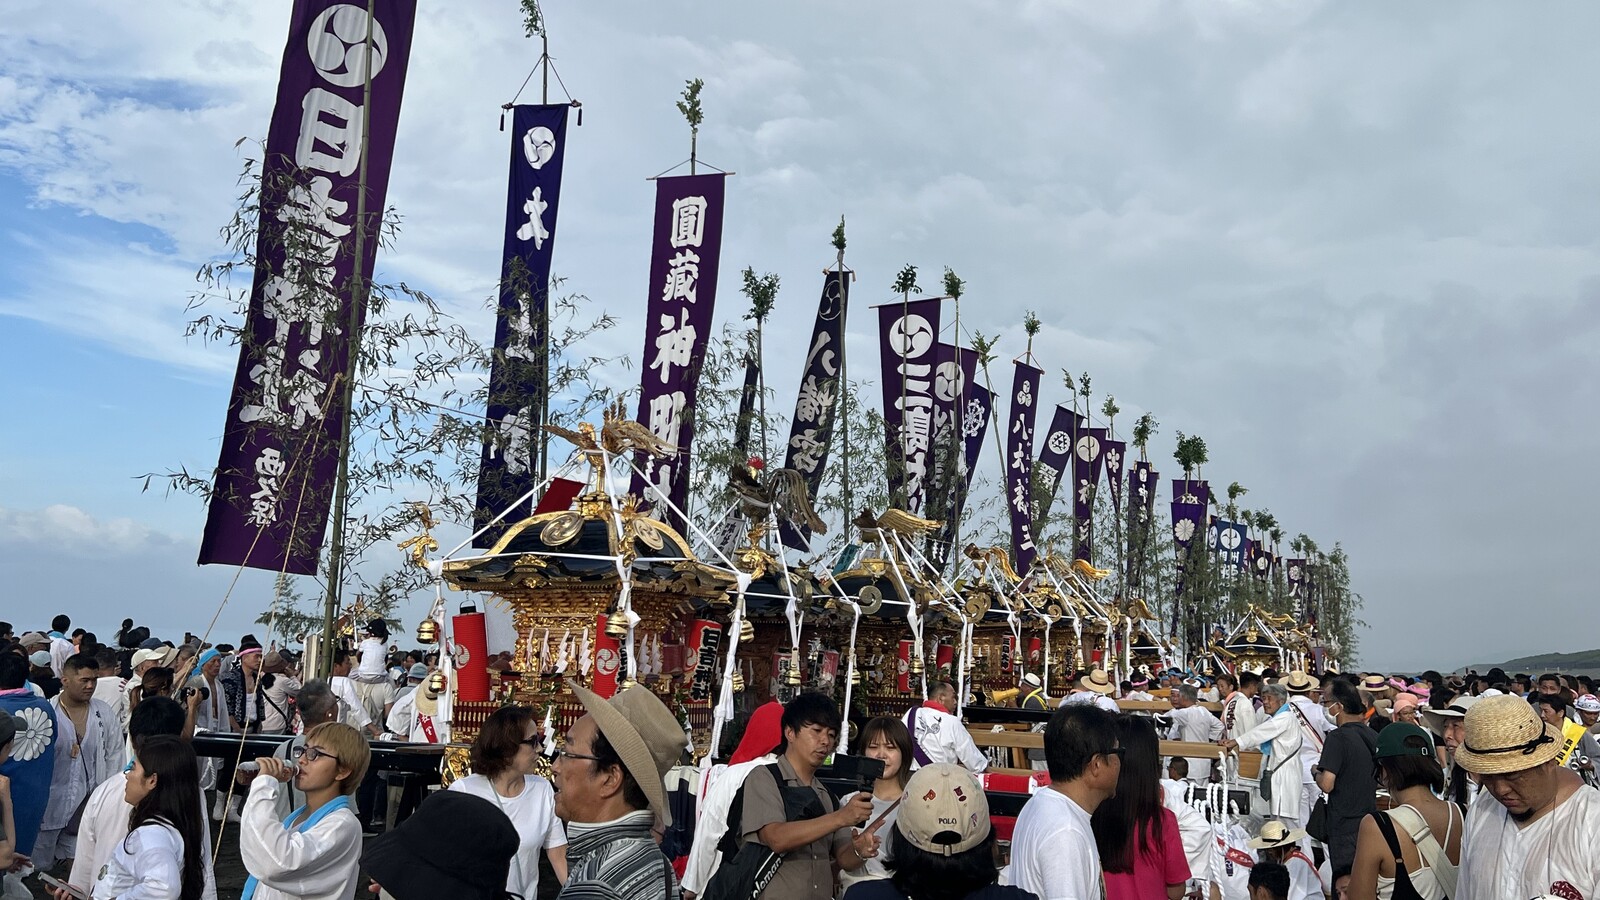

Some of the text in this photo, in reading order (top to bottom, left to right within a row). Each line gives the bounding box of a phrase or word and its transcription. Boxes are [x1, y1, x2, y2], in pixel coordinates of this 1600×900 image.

[691, 628, 722, 700] 日吉神社
[938, 817, 957, 825] POLO
[750, 857, 782, 900] oleman
